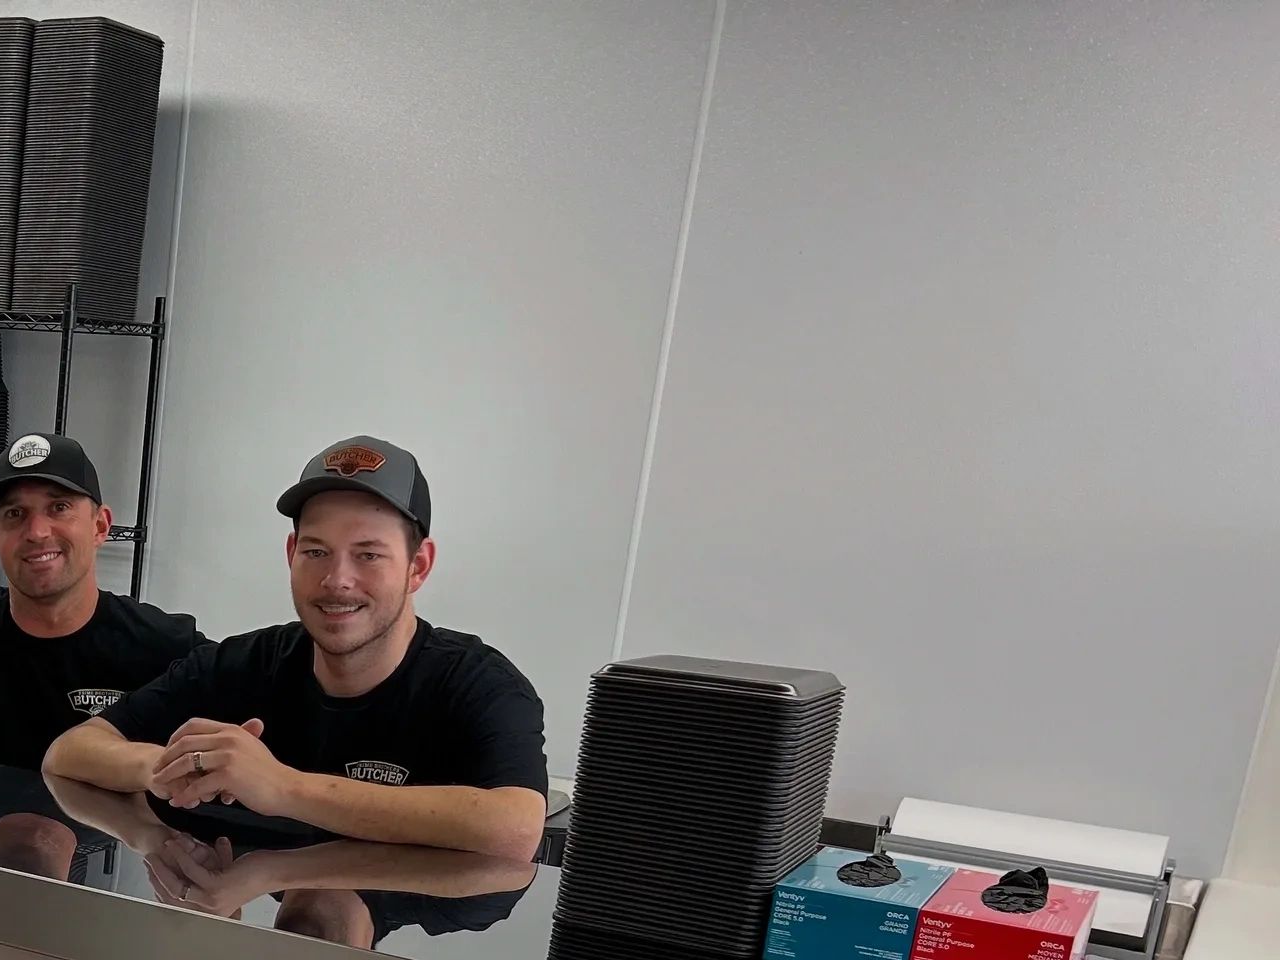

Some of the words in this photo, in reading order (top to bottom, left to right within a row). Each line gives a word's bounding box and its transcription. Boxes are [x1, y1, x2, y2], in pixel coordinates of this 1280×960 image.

[11, 449, 49, 463] BUTCHER
[329, 453, 378, 465] BUTCHER
[351, 768, 404, 785] BUTCHER
[778, 891, 805, 902] Ventyv
[887, 911, 910, 921] ORCA
[884, 921, 909, 929] GRAND
[923, 917, 953, 929] Ventyv
[879, 926, 908, 935] GRANDE
[918, 940, 938, 948] CORE
[919, 933, 945, 943] General
[946, 938, 975, 949] Purpose
[1040, 941, 1065, 951] ORCA
[1037, 950, 1064, 959] MOYEN
